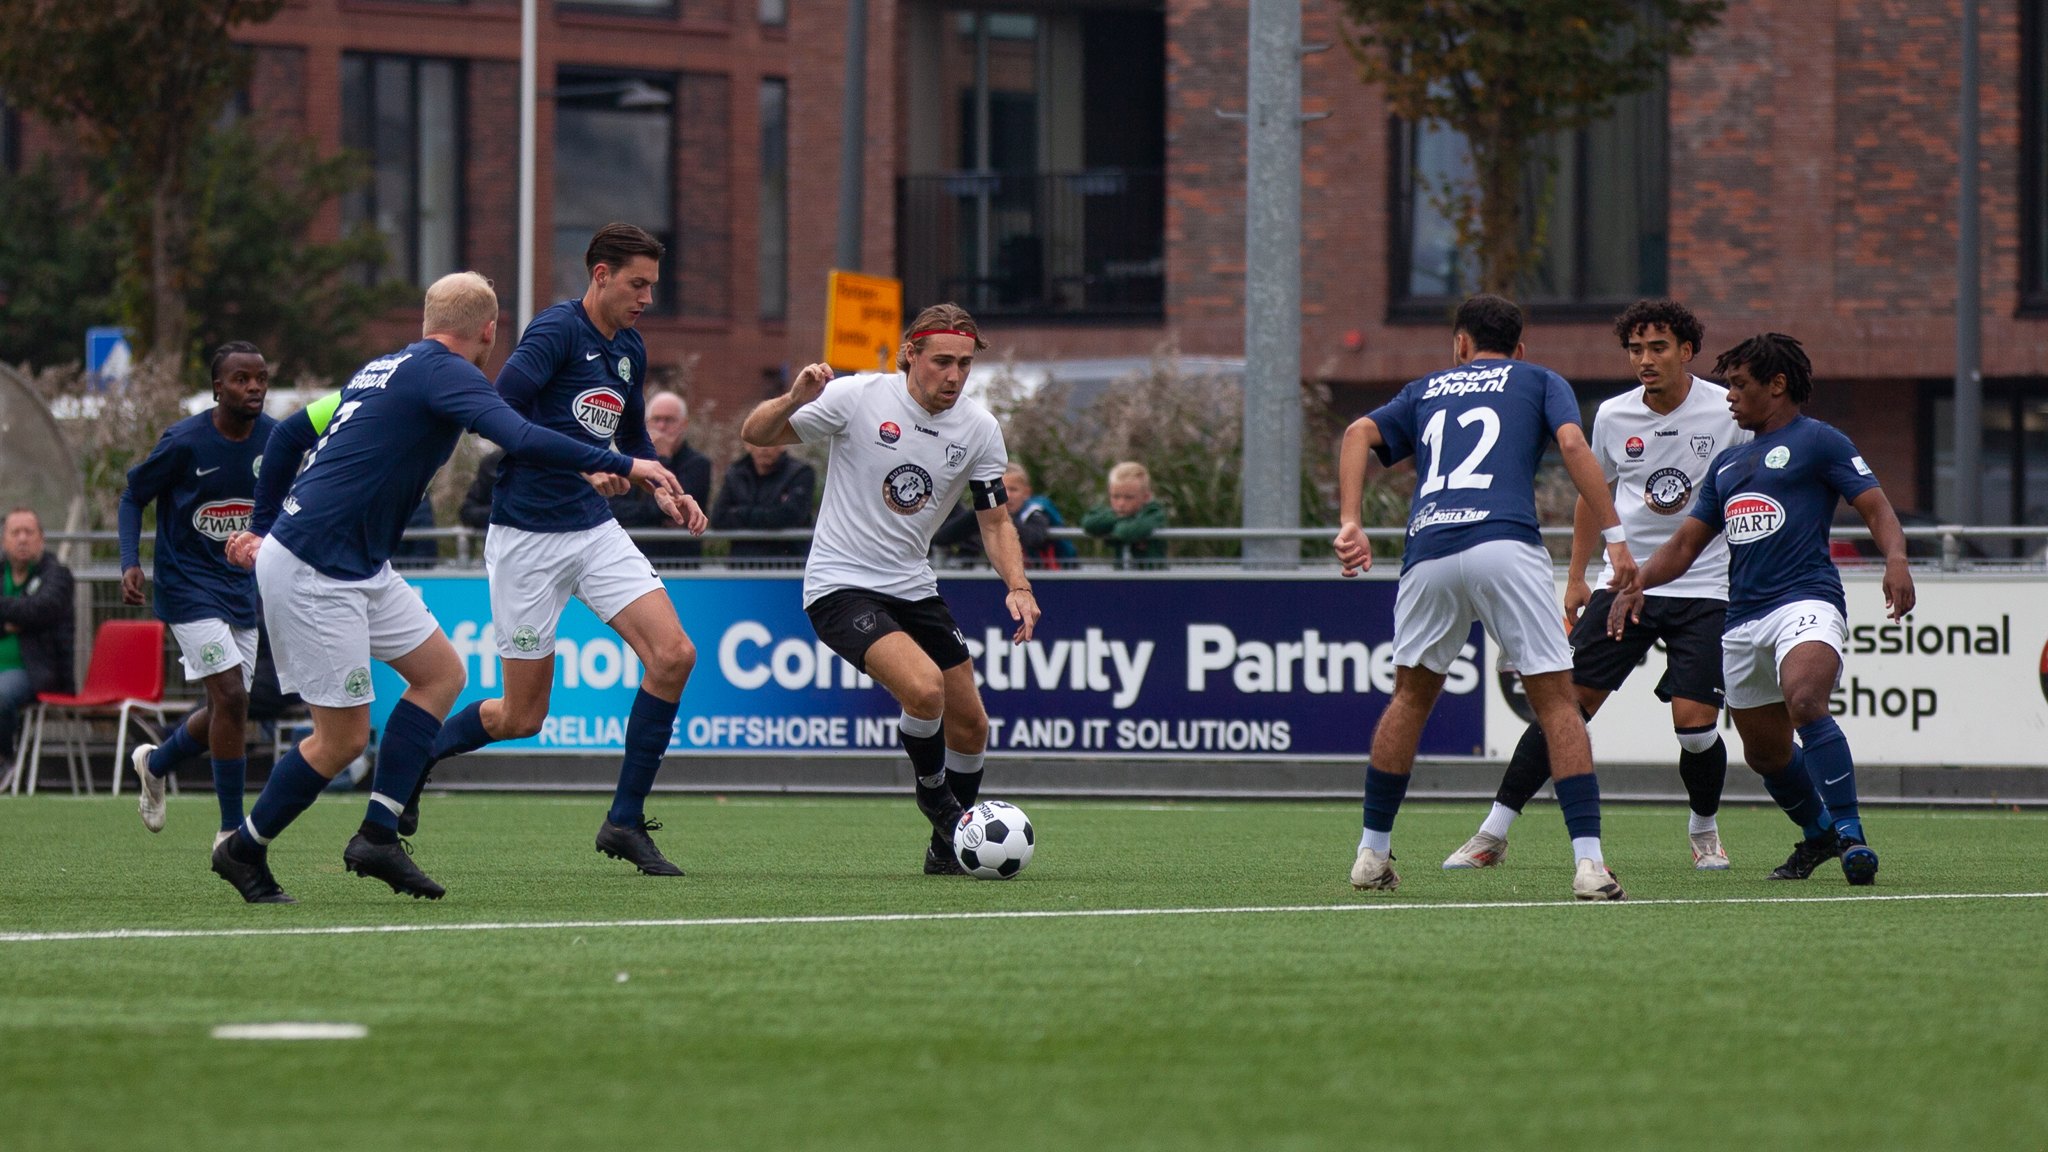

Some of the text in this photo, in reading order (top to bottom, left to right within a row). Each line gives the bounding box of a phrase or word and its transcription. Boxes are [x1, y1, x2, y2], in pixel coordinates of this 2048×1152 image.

[1422, 377, 1509, 400] shop.nl
[914, 423, 939, 438] hummel
[1419, 406, 1501, 499] 12
[889, 465, 932, 491] BUSINESSCLUB
[1647, 468, 1691, 489] BUSINESSCLUB
[1726, 514, 1777, 537] WART
[1798, 613, 1818, 628] 22
[1187, 623, 1480, 695] Partnes
[687, 716, 848, 748] OFFSHORE
[855, 717, 1006, 748] INTT
[1009, 718, 1076, 749] AND
[1081, 719, 1111, 749] IT
[1115, 719, 1292, 751] SOLUTIONS
